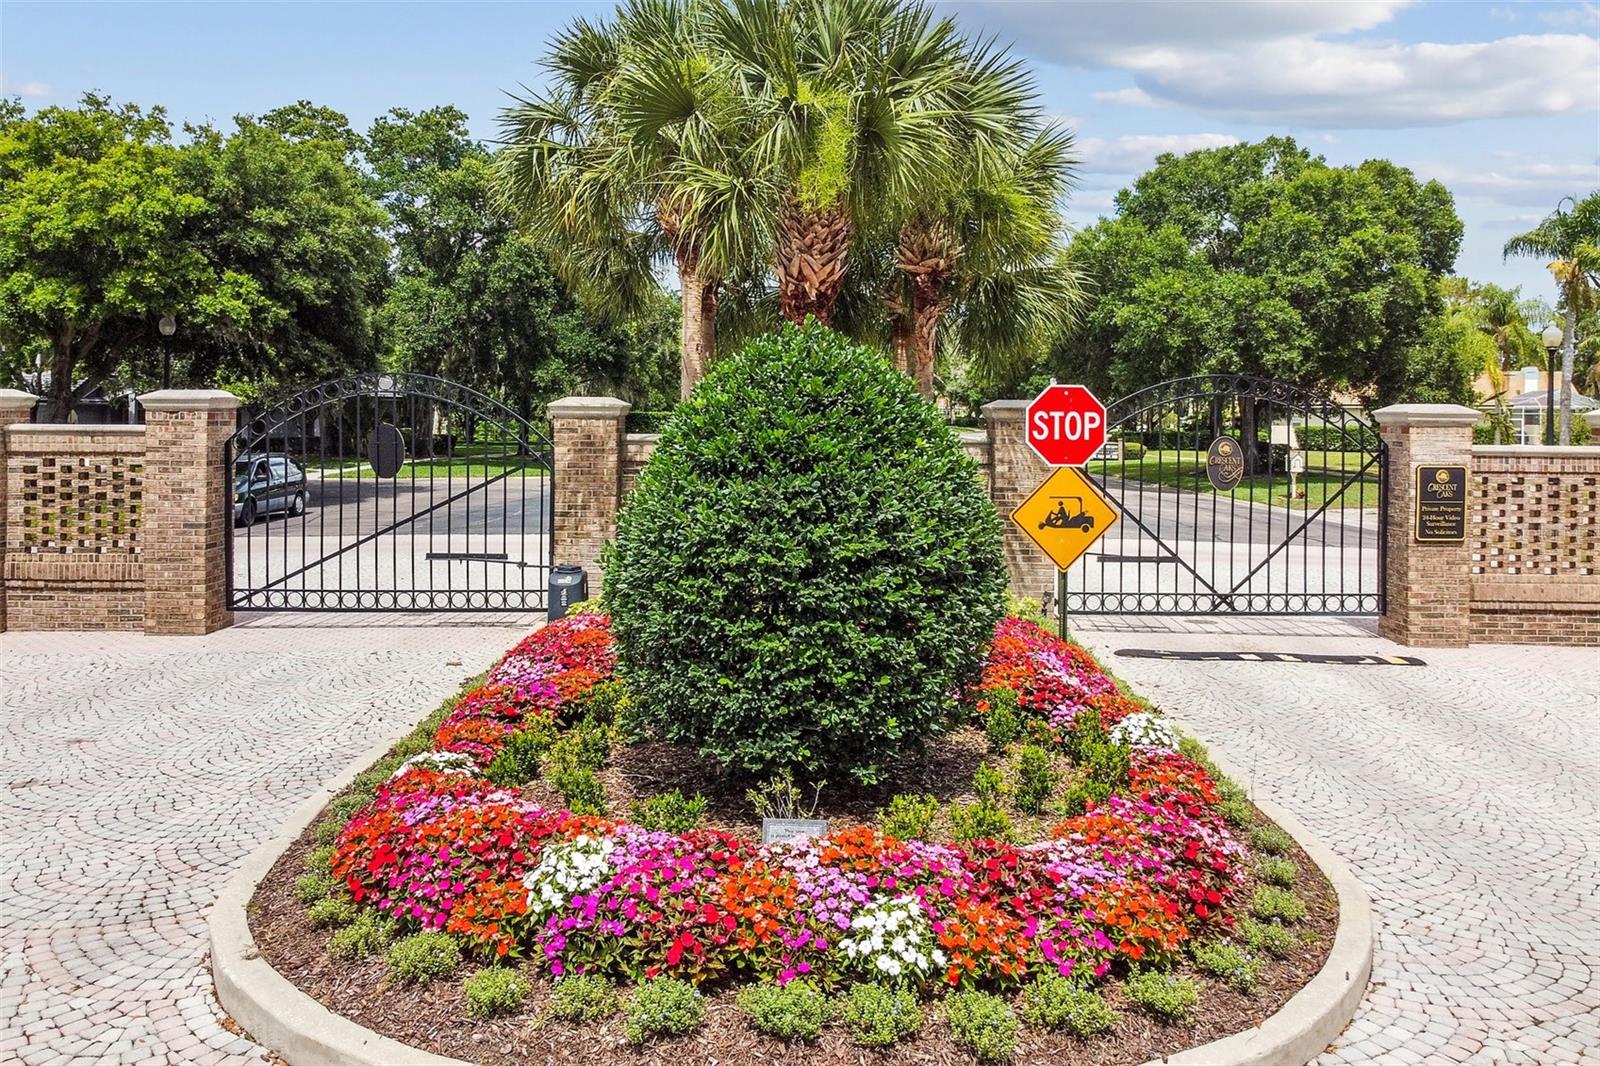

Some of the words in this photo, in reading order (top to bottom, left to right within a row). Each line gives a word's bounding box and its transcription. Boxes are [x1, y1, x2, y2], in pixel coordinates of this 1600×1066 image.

[1032, 411, 1101, 441] STOP
[1428, 483, 1458, 492] CRESCENT
[1436, 490, 1453, 498] OAKS
